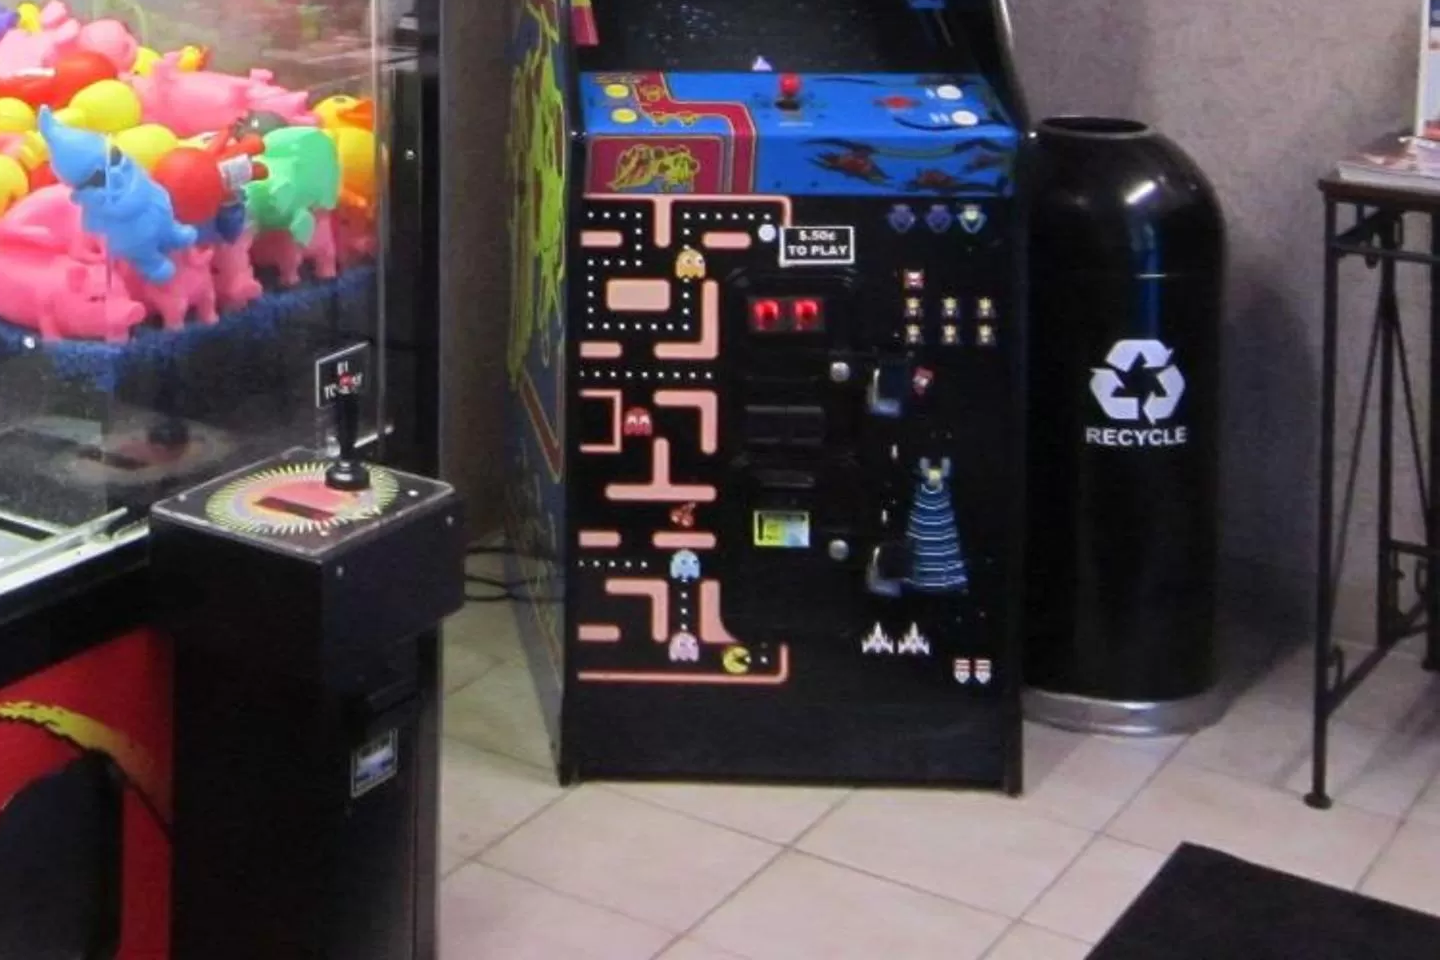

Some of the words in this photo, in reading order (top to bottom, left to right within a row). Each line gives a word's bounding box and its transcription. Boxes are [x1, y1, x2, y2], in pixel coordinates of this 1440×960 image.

[787, 245, 808, 256] TO
[810, 245, 848, 257] PLAY
[1085, 426, 1187, 446] RECYCLE
